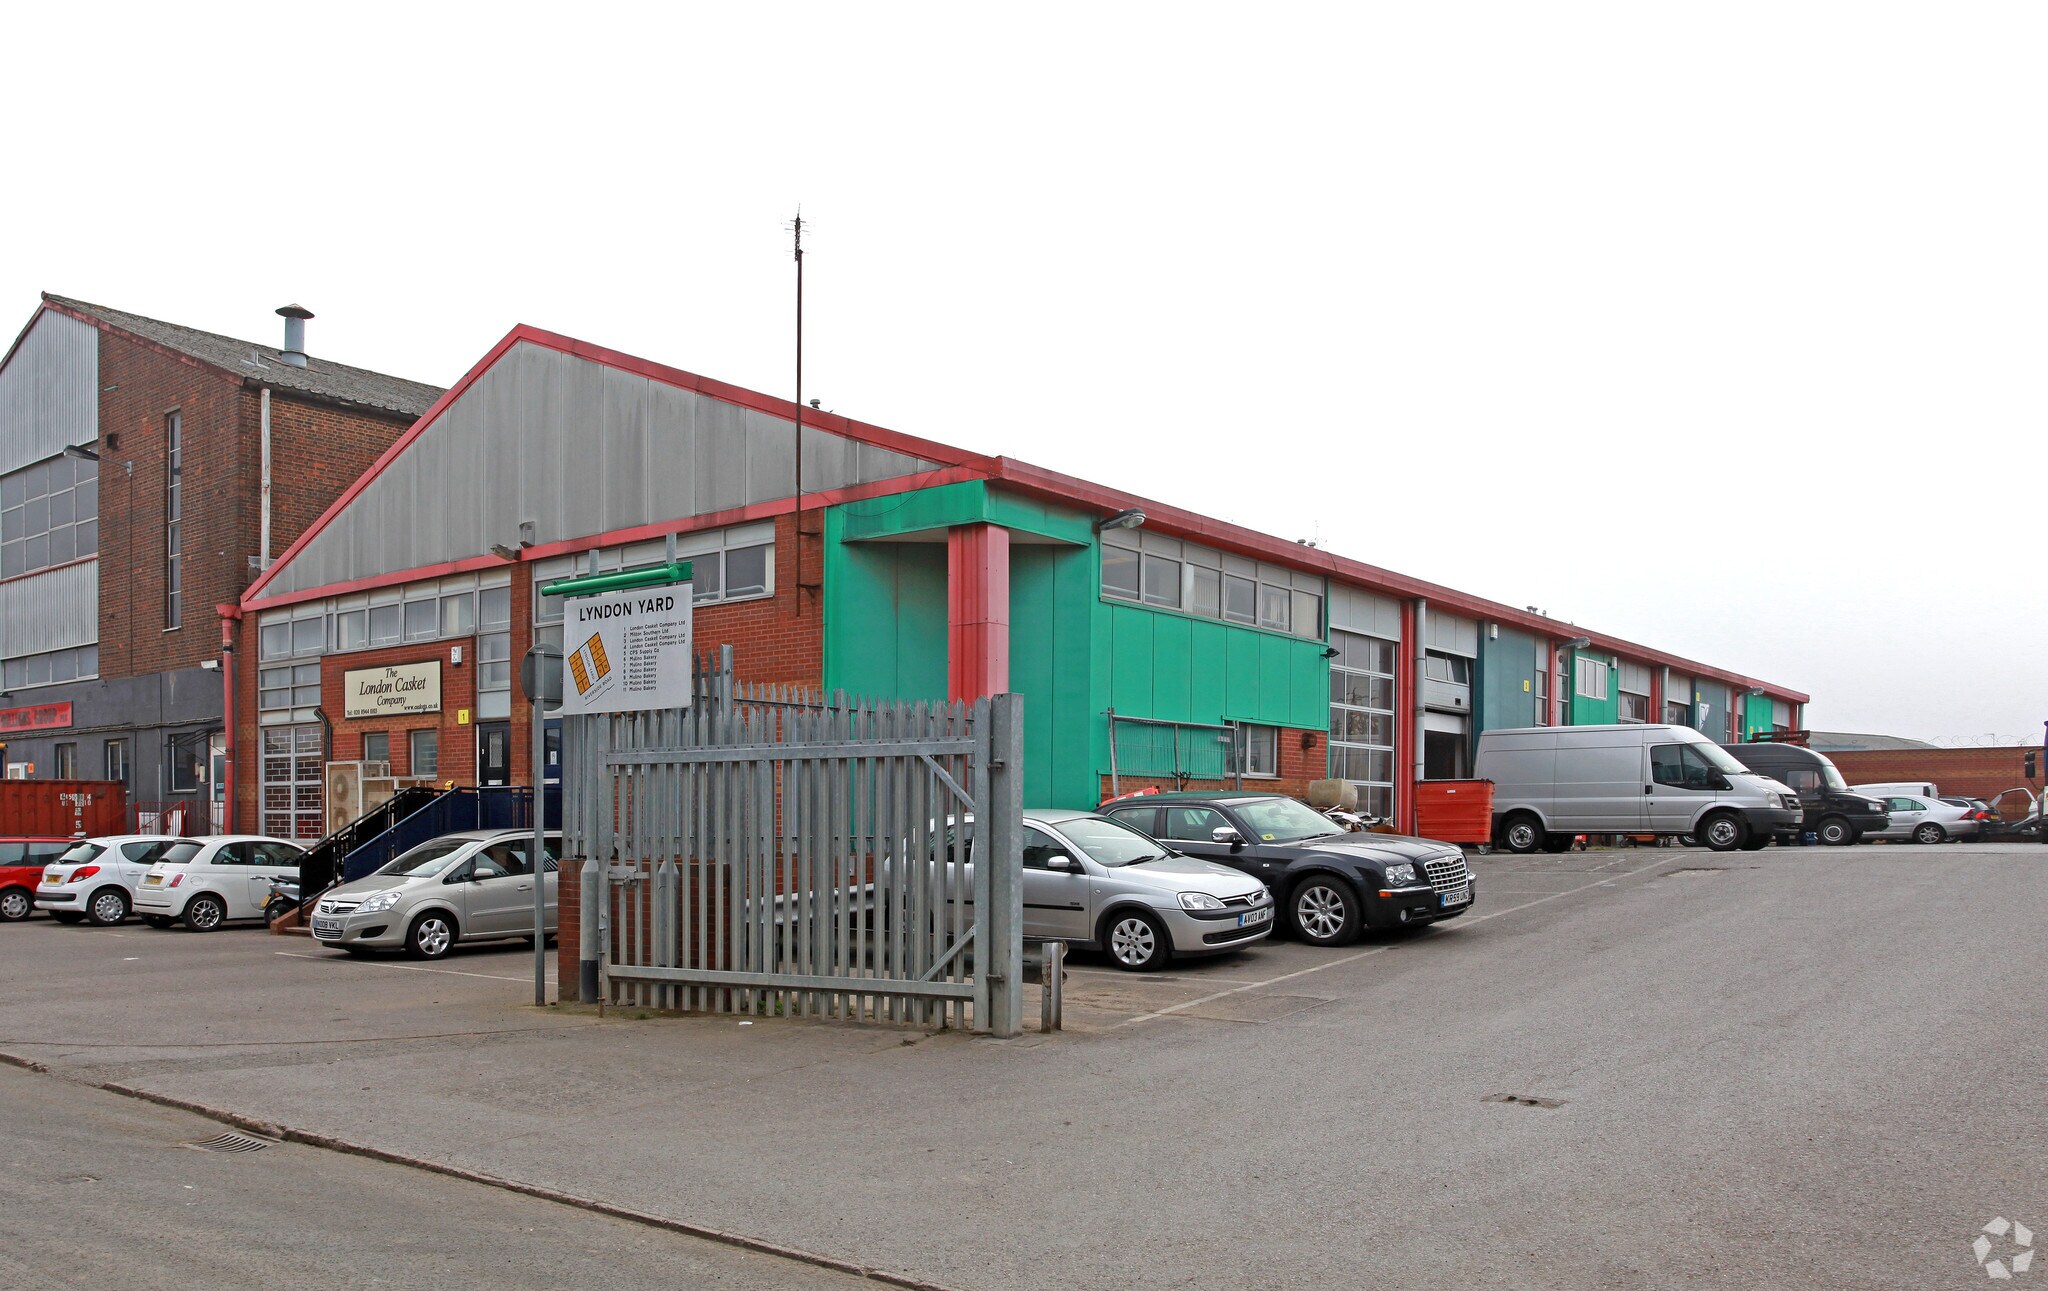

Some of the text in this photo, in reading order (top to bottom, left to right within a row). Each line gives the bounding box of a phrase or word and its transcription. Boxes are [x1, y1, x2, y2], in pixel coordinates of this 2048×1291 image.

[580, 596, 674, 622] LYNDON YARD
[386, 668, 398, 678] The
[359, 676, 426, 695] London Casket
[377, 696, 406, 707] Company
[1445, 893, 1459, 904] KR59
[1244, 912, 1258, 924] AV03
